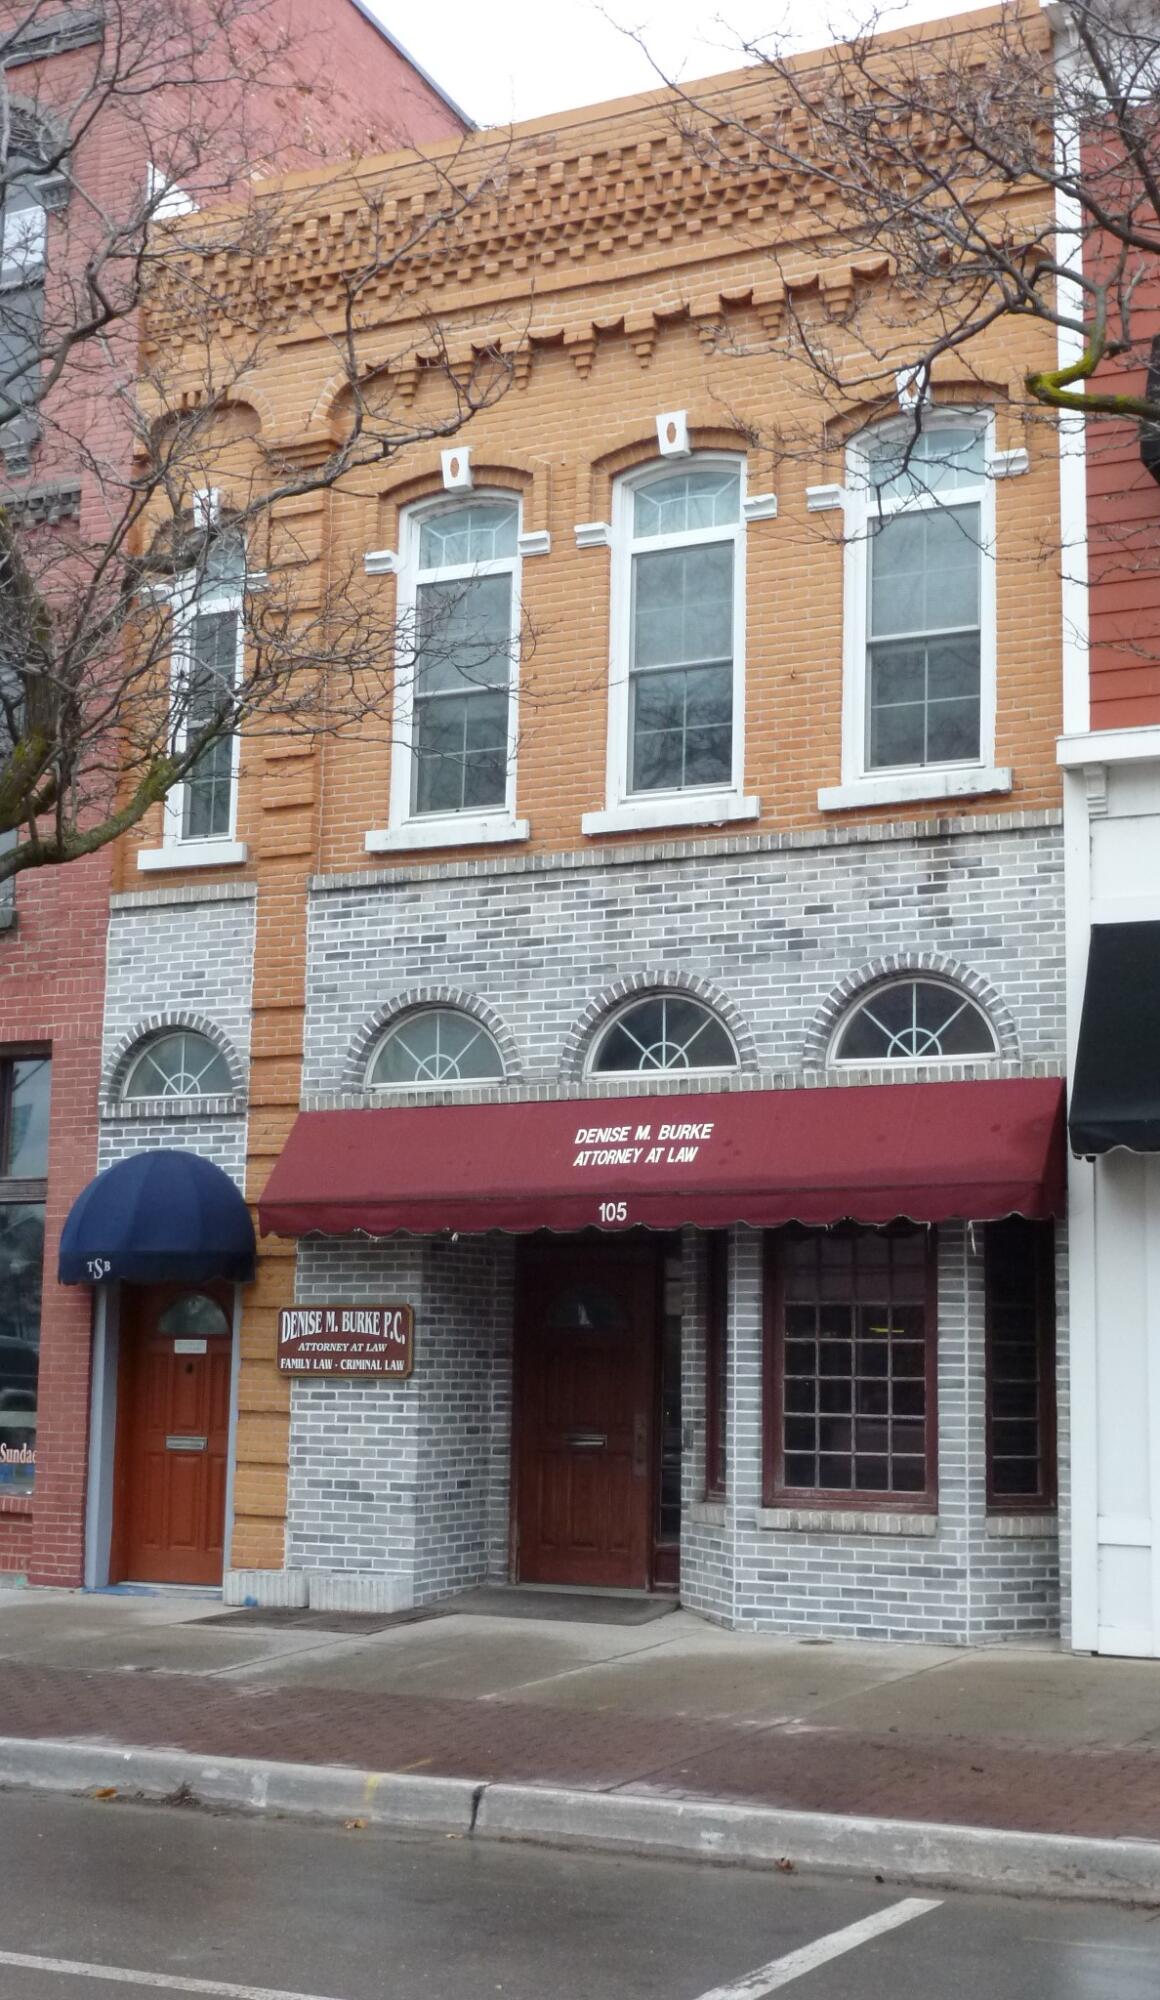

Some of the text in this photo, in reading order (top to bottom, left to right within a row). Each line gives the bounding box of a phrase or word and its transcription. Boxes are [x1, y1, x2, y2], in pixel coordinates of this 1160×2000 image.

[574, 1123, 714, 1144] DENISE M. BURKE
[572, 1146, 699, 1166] ATTORNEY AT LAW
[598, 1202, 627, 1222] 105
[281, 1311, 406, 1344] DENISE M. BURKE P.C.
[298, 1342, 387, 1352] ATTORNEY AT LAW
[280, 1358, 405, 1371] FAMILY LAW CRIMINAL LAW
